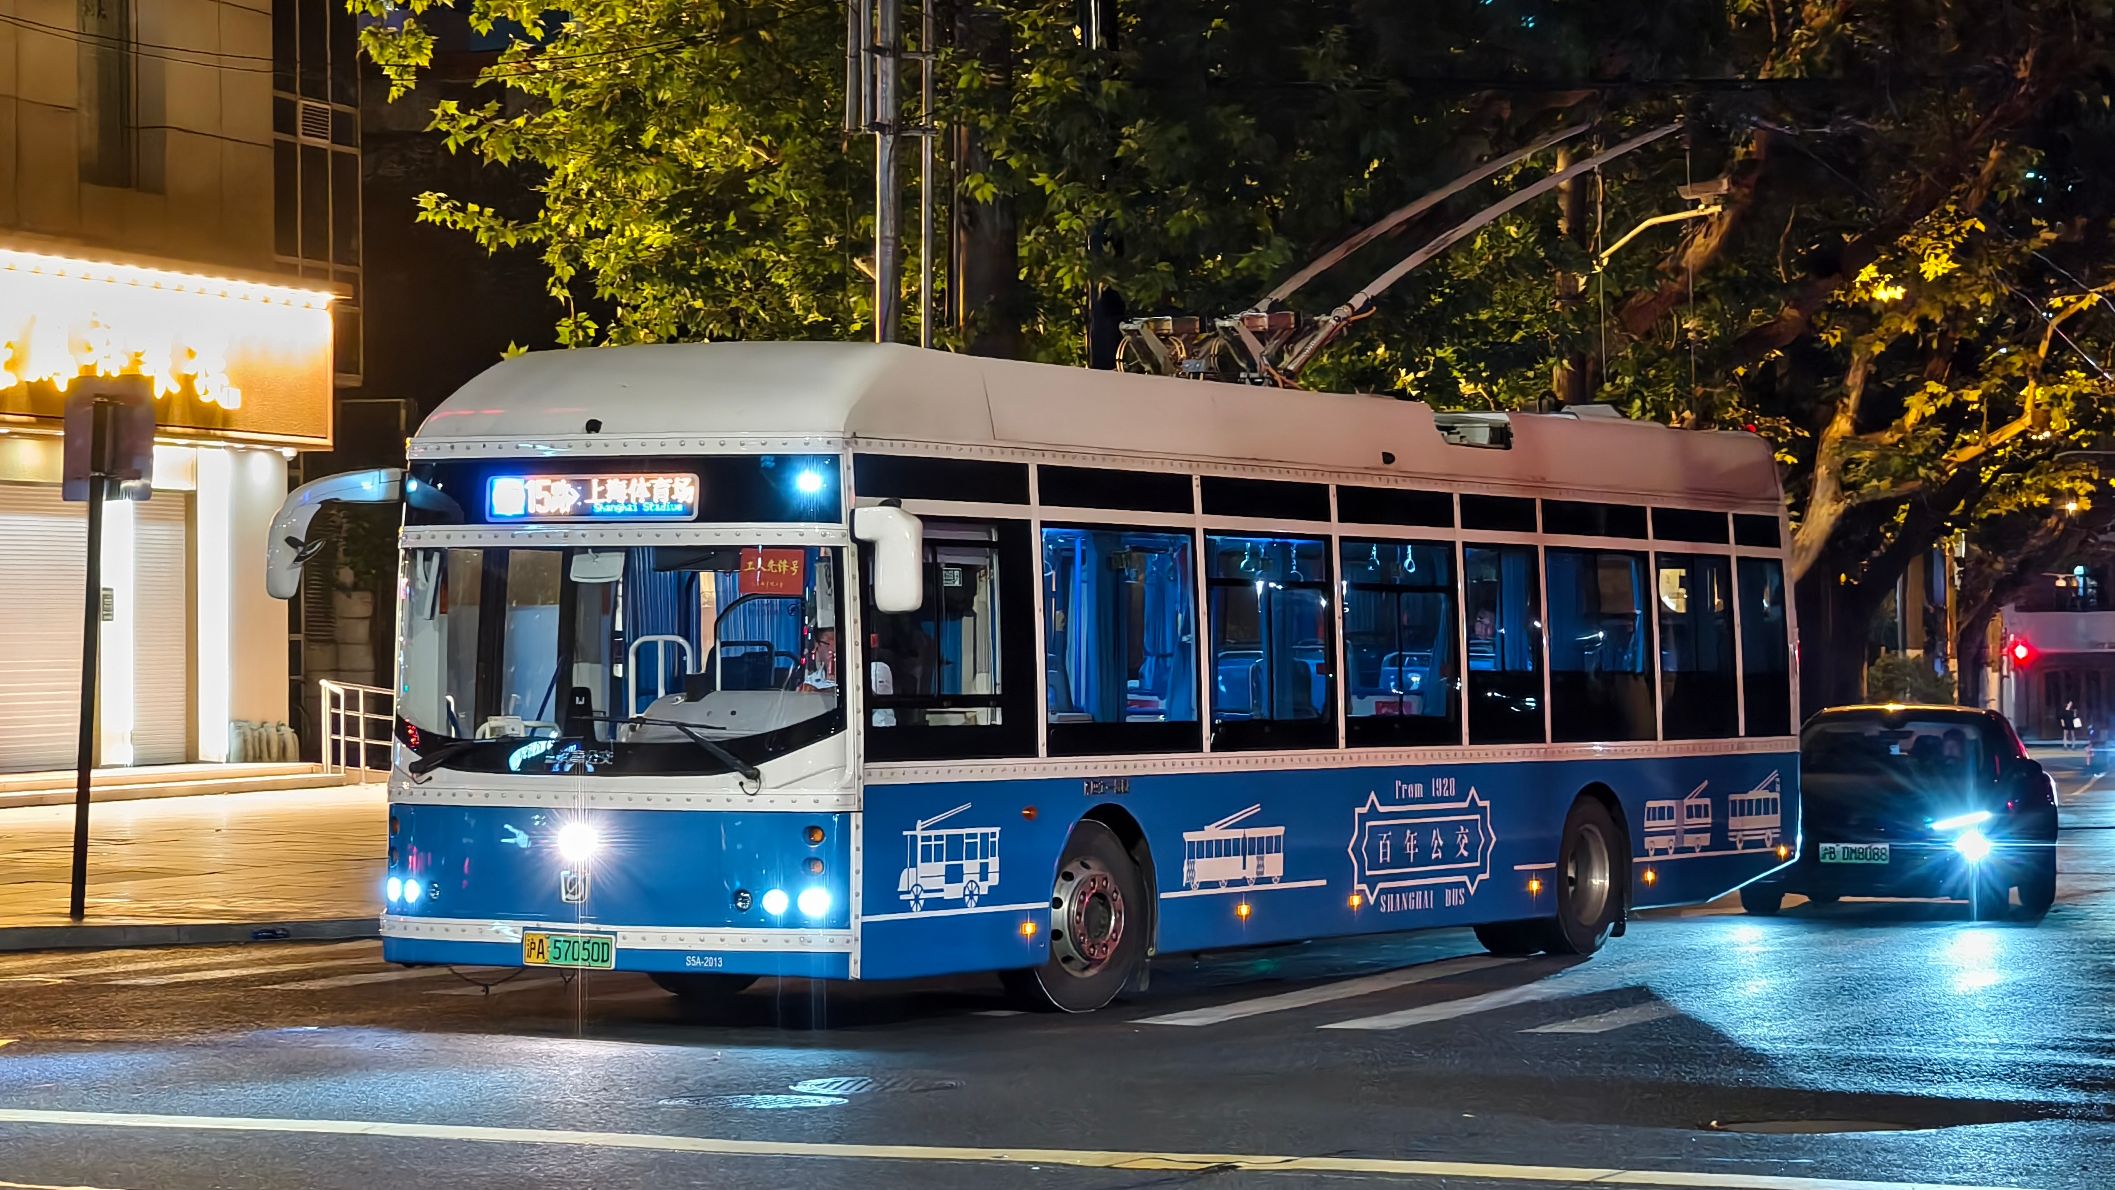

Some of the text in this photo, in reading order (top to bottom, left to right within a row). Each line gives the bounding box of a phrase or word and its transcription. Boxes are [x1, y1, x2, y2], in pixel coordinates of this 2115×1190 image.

[584, 477, 695, 504] 上海体育场
[593, 502, 638, 513] Shanghai
[1377, 825, 1470, 864] 百年公交
[1380, 888, 1466, 913] SHANGHAI BUS
[553, 939, 610, 963] 57050D
[686, 955, 723, 968] S5A-2013
